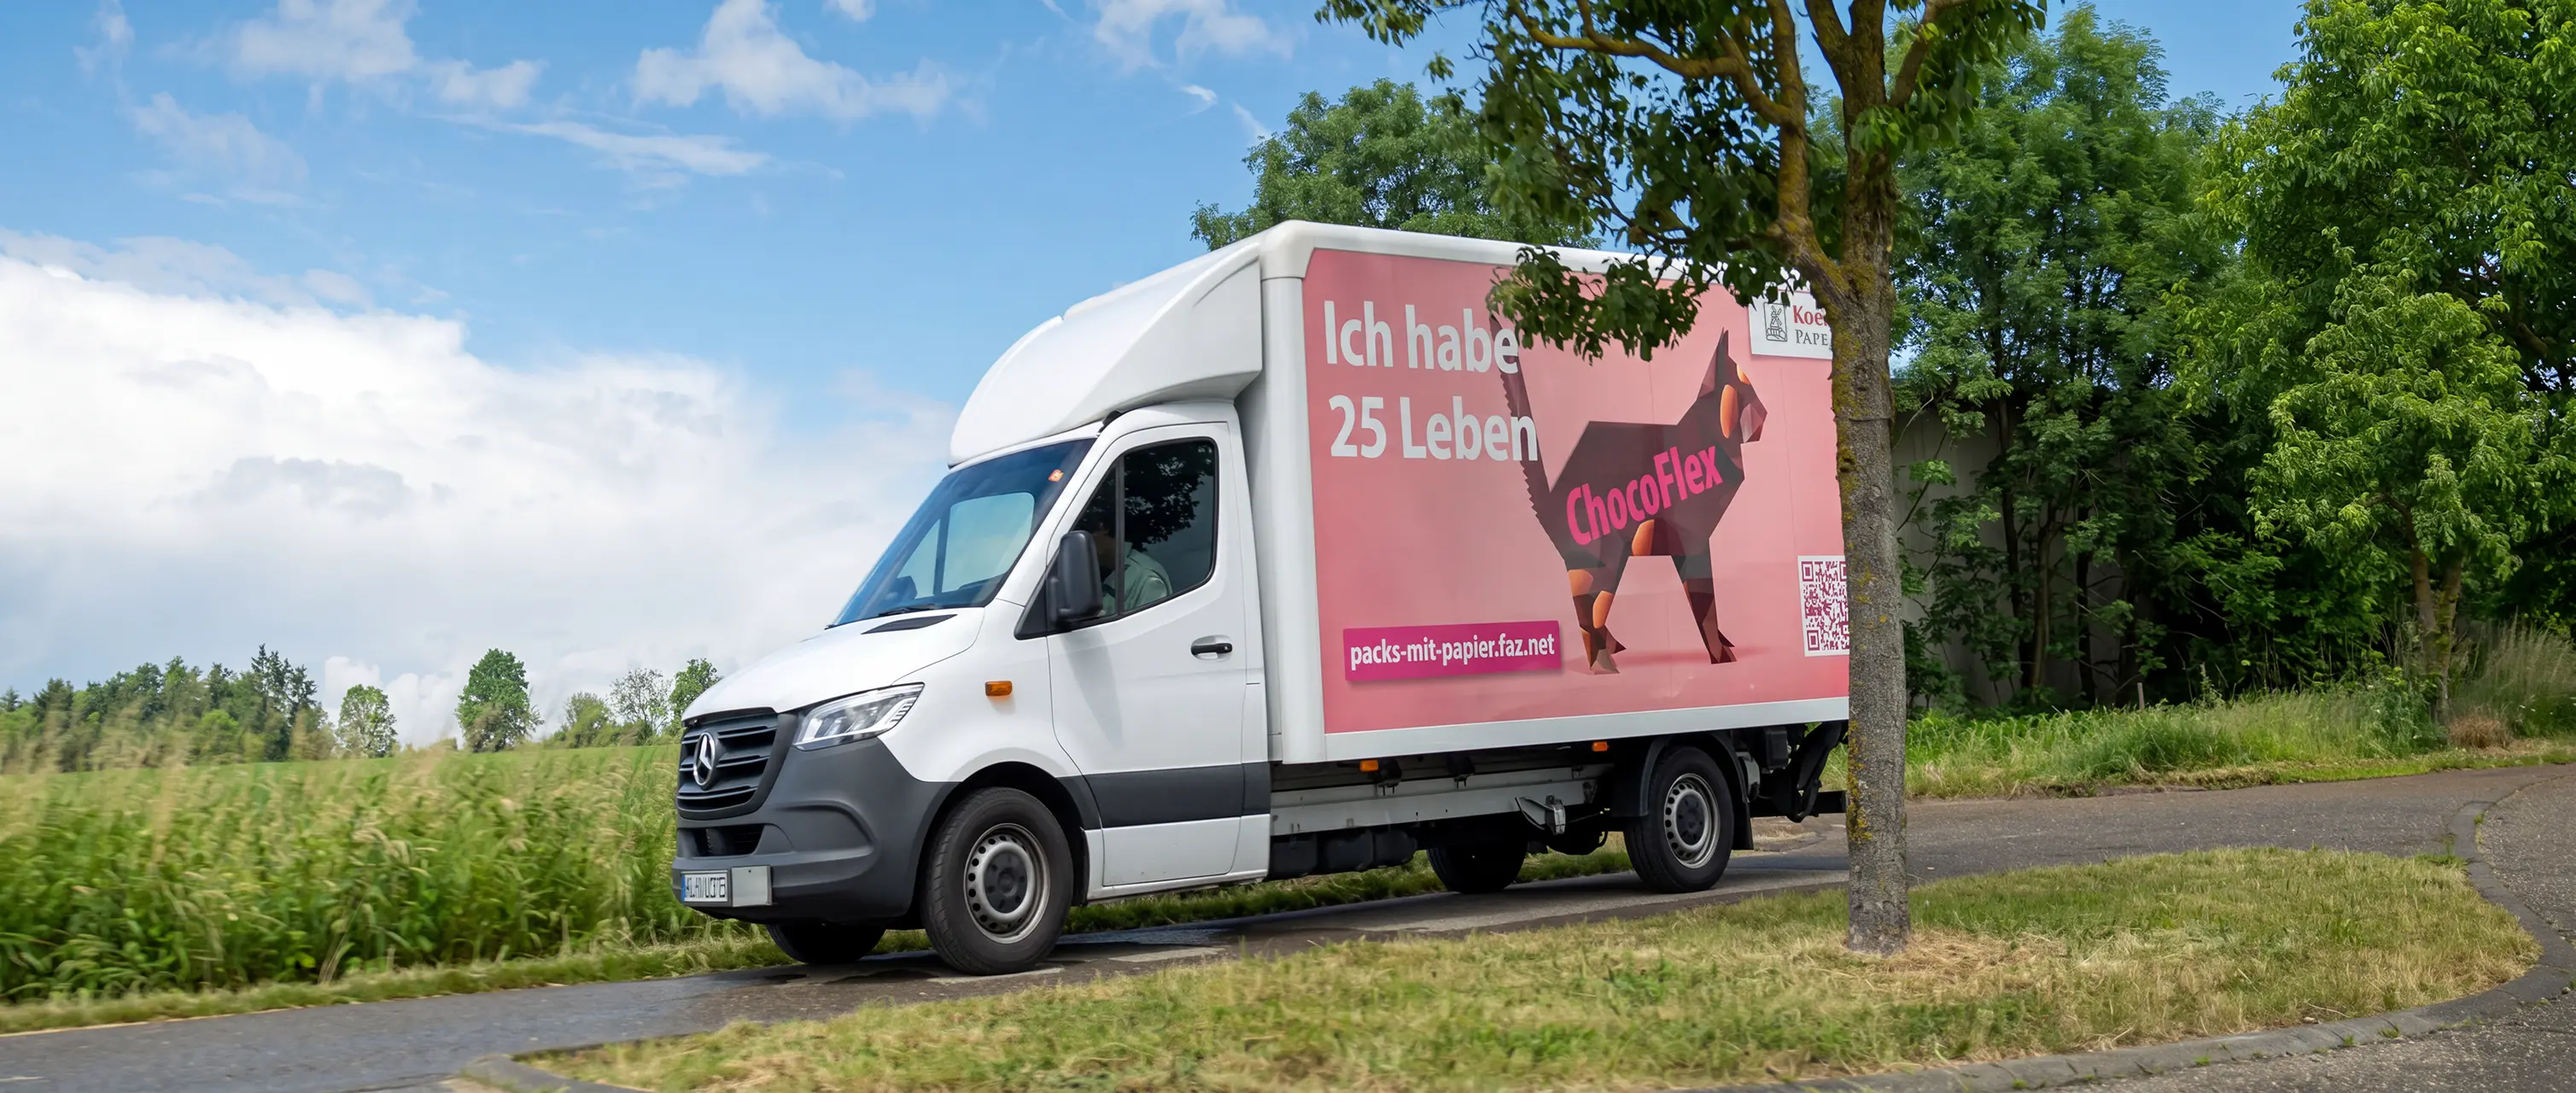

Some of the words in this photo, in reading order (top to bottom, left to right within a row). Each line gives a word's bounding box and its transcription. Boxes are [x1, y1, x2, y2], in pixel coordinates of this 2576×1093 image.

[1324, 300, 1393, 367] Ich
[1405, 303, 1519, 373] habe
[1792, 305, 1827, 326] Koe
[1795, 329, 1831, 346] PAPE
[1329, 395, 1387, 459] 25
[1399, 395, 1538, 461] Leben
[1566, 446, 1723, 546] ChocoFlex
[1350, 633, 1555, 670] packs-mit-papier.faz.net
